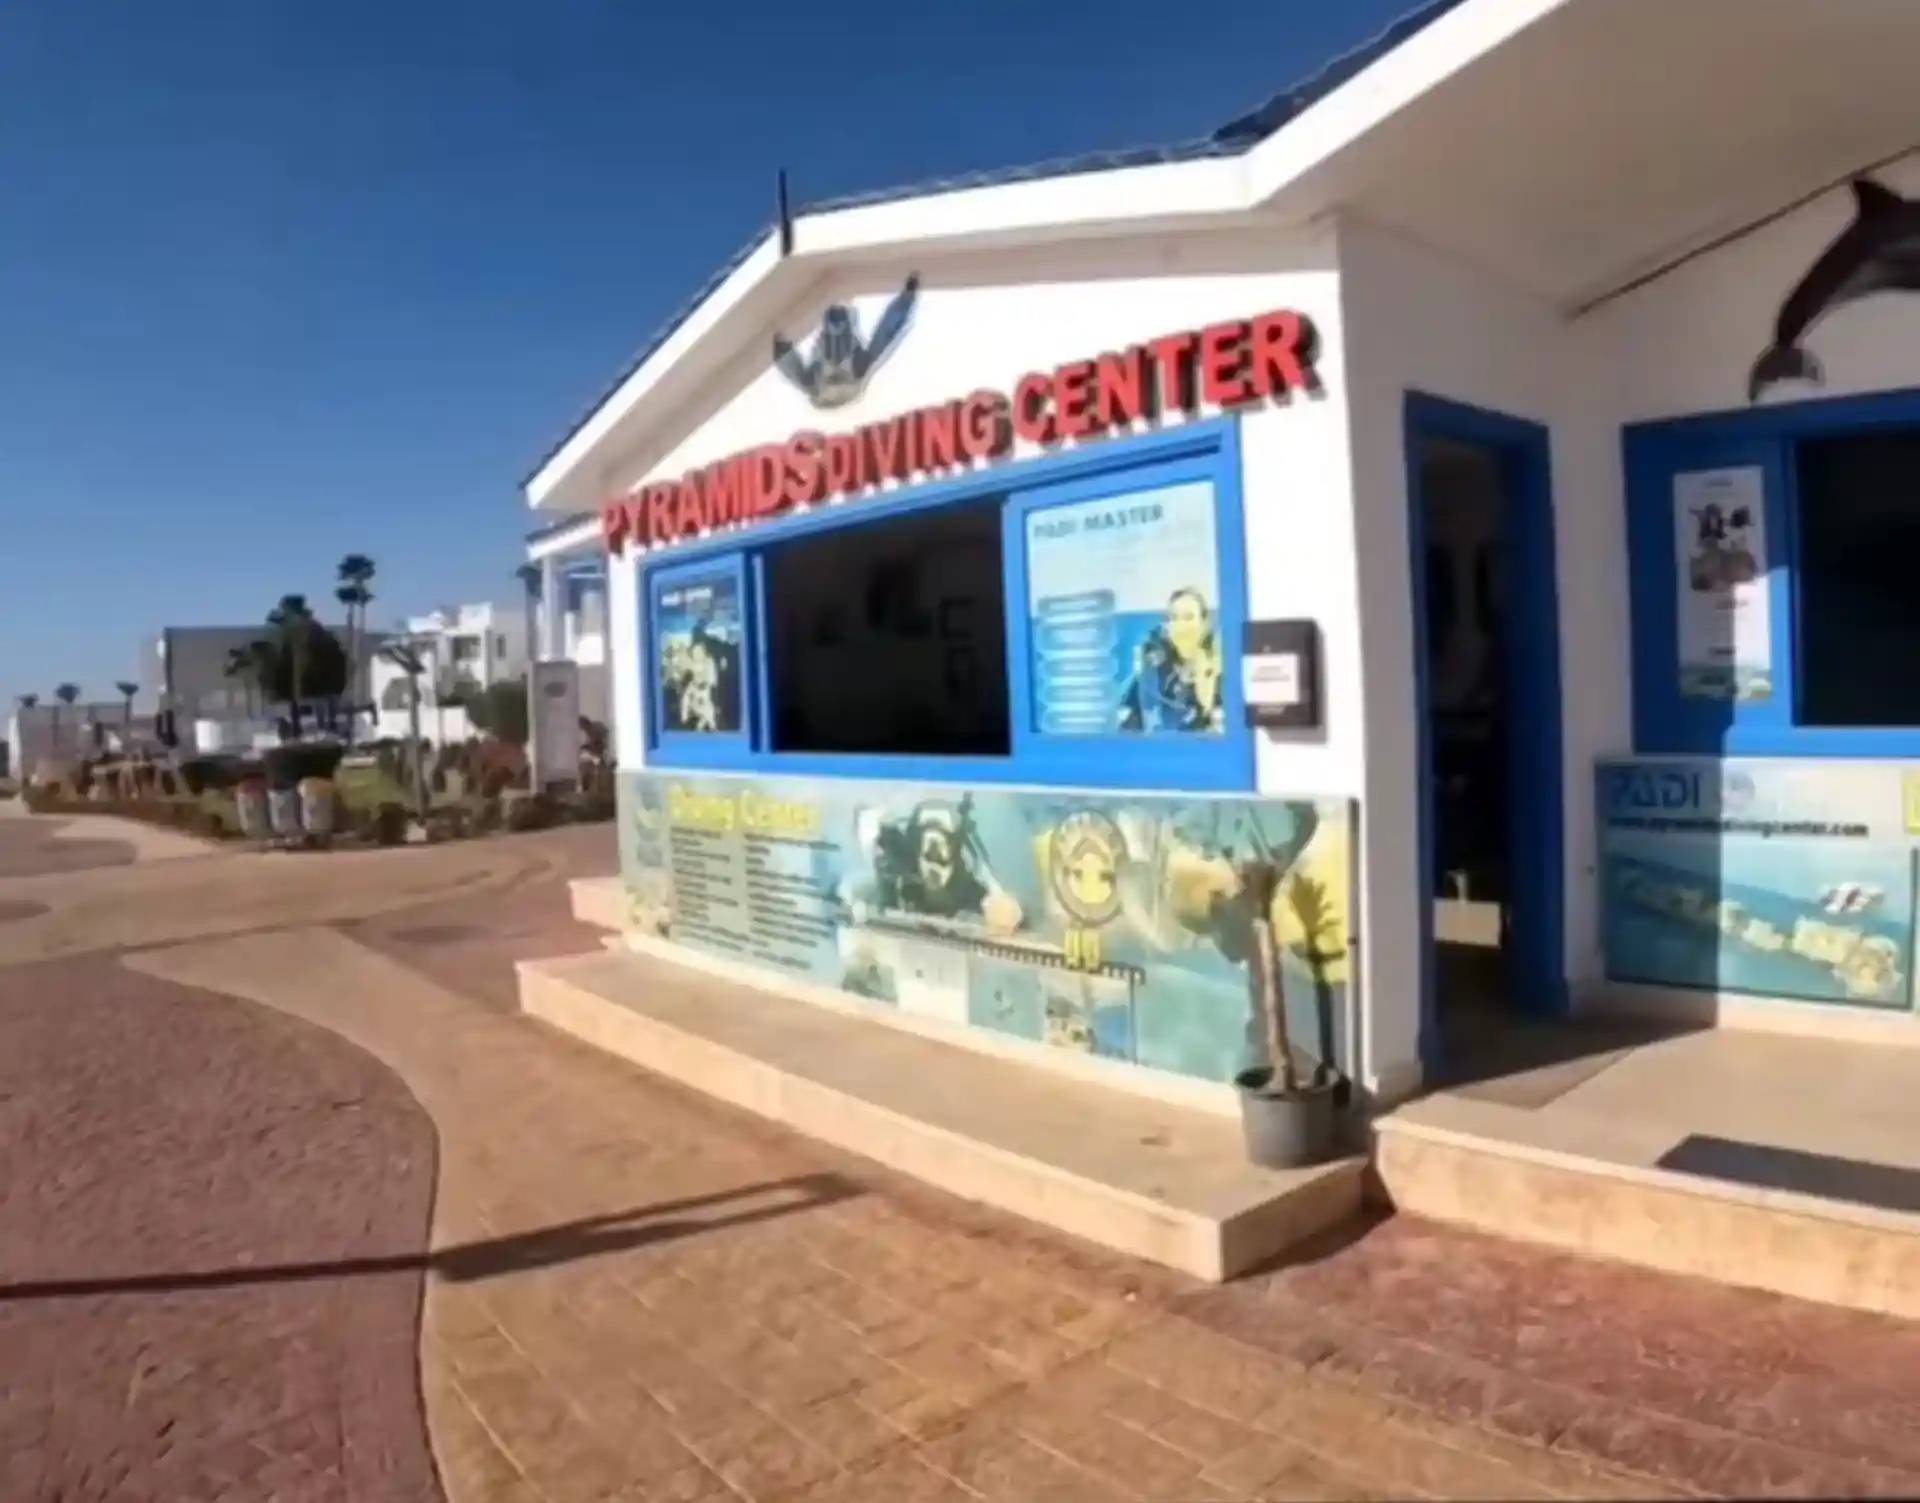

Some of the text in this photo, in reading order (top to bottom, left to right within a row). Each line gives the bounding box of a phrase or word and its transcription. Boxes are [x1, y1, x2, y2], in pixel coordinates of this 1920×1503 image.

[602, 308, 1320, 554] PYRAMIDS DIVING CENTER
[1084, 503, 1164, 532] MASTER
[1610, 772, 1699, 809] PADI
